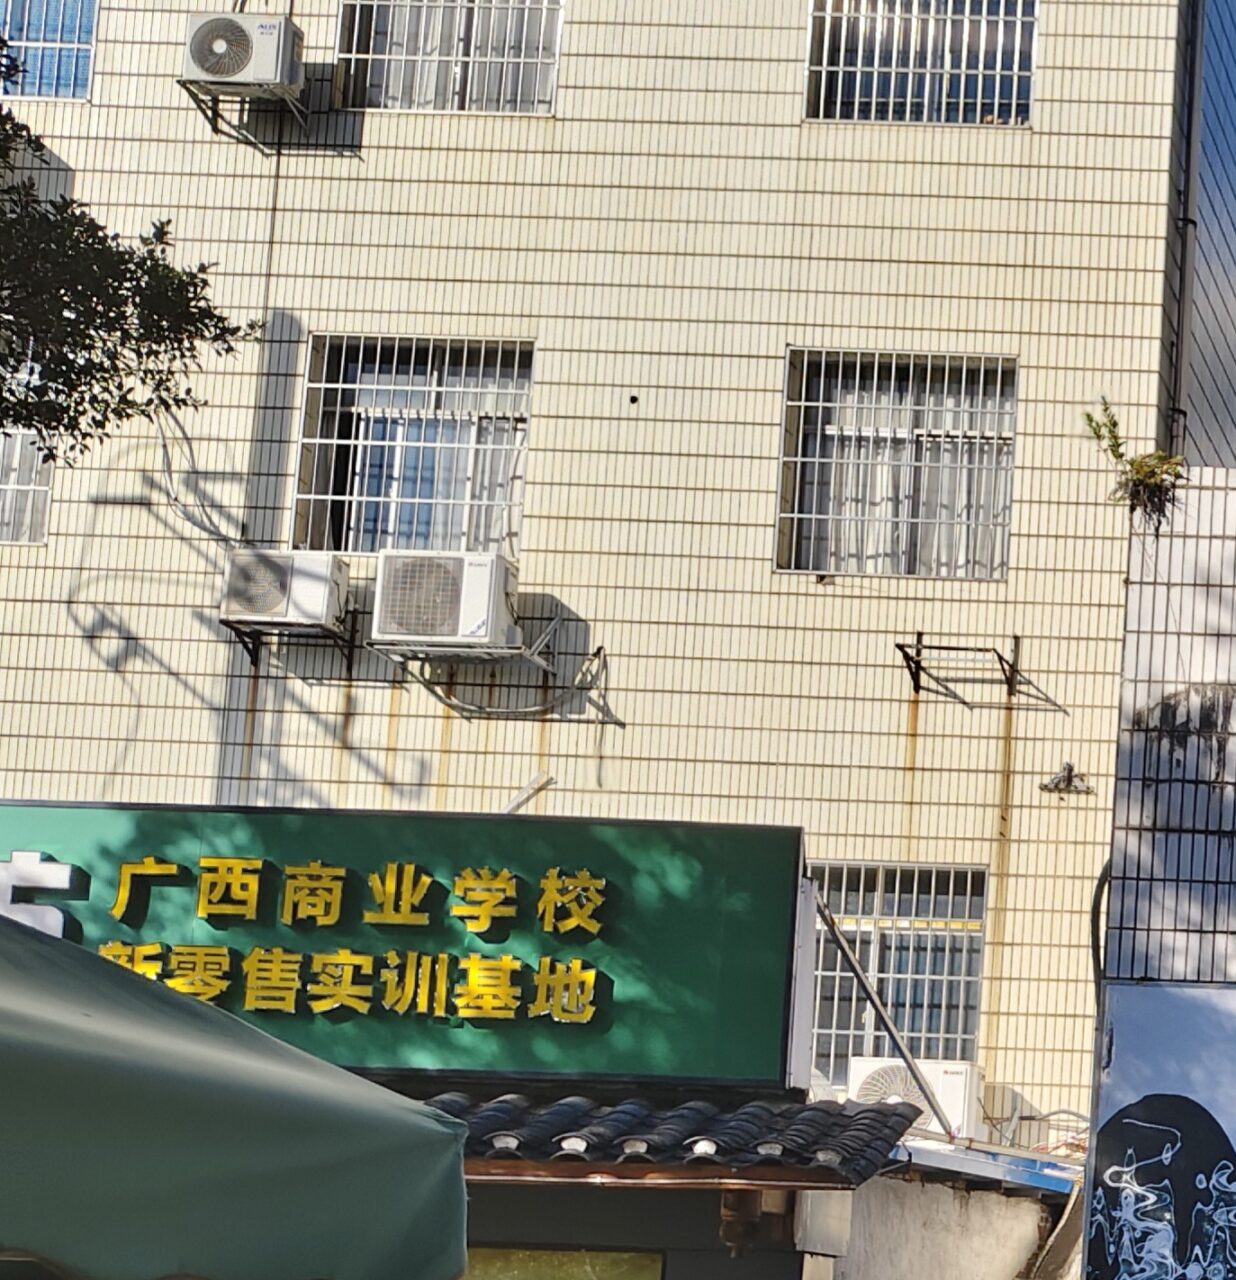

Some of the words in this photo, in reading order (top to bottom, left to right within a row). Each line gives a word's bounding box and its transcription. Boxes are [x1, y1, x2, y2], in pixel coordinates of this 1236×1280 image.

[108, 856, 606, 934] 广西商业学校
